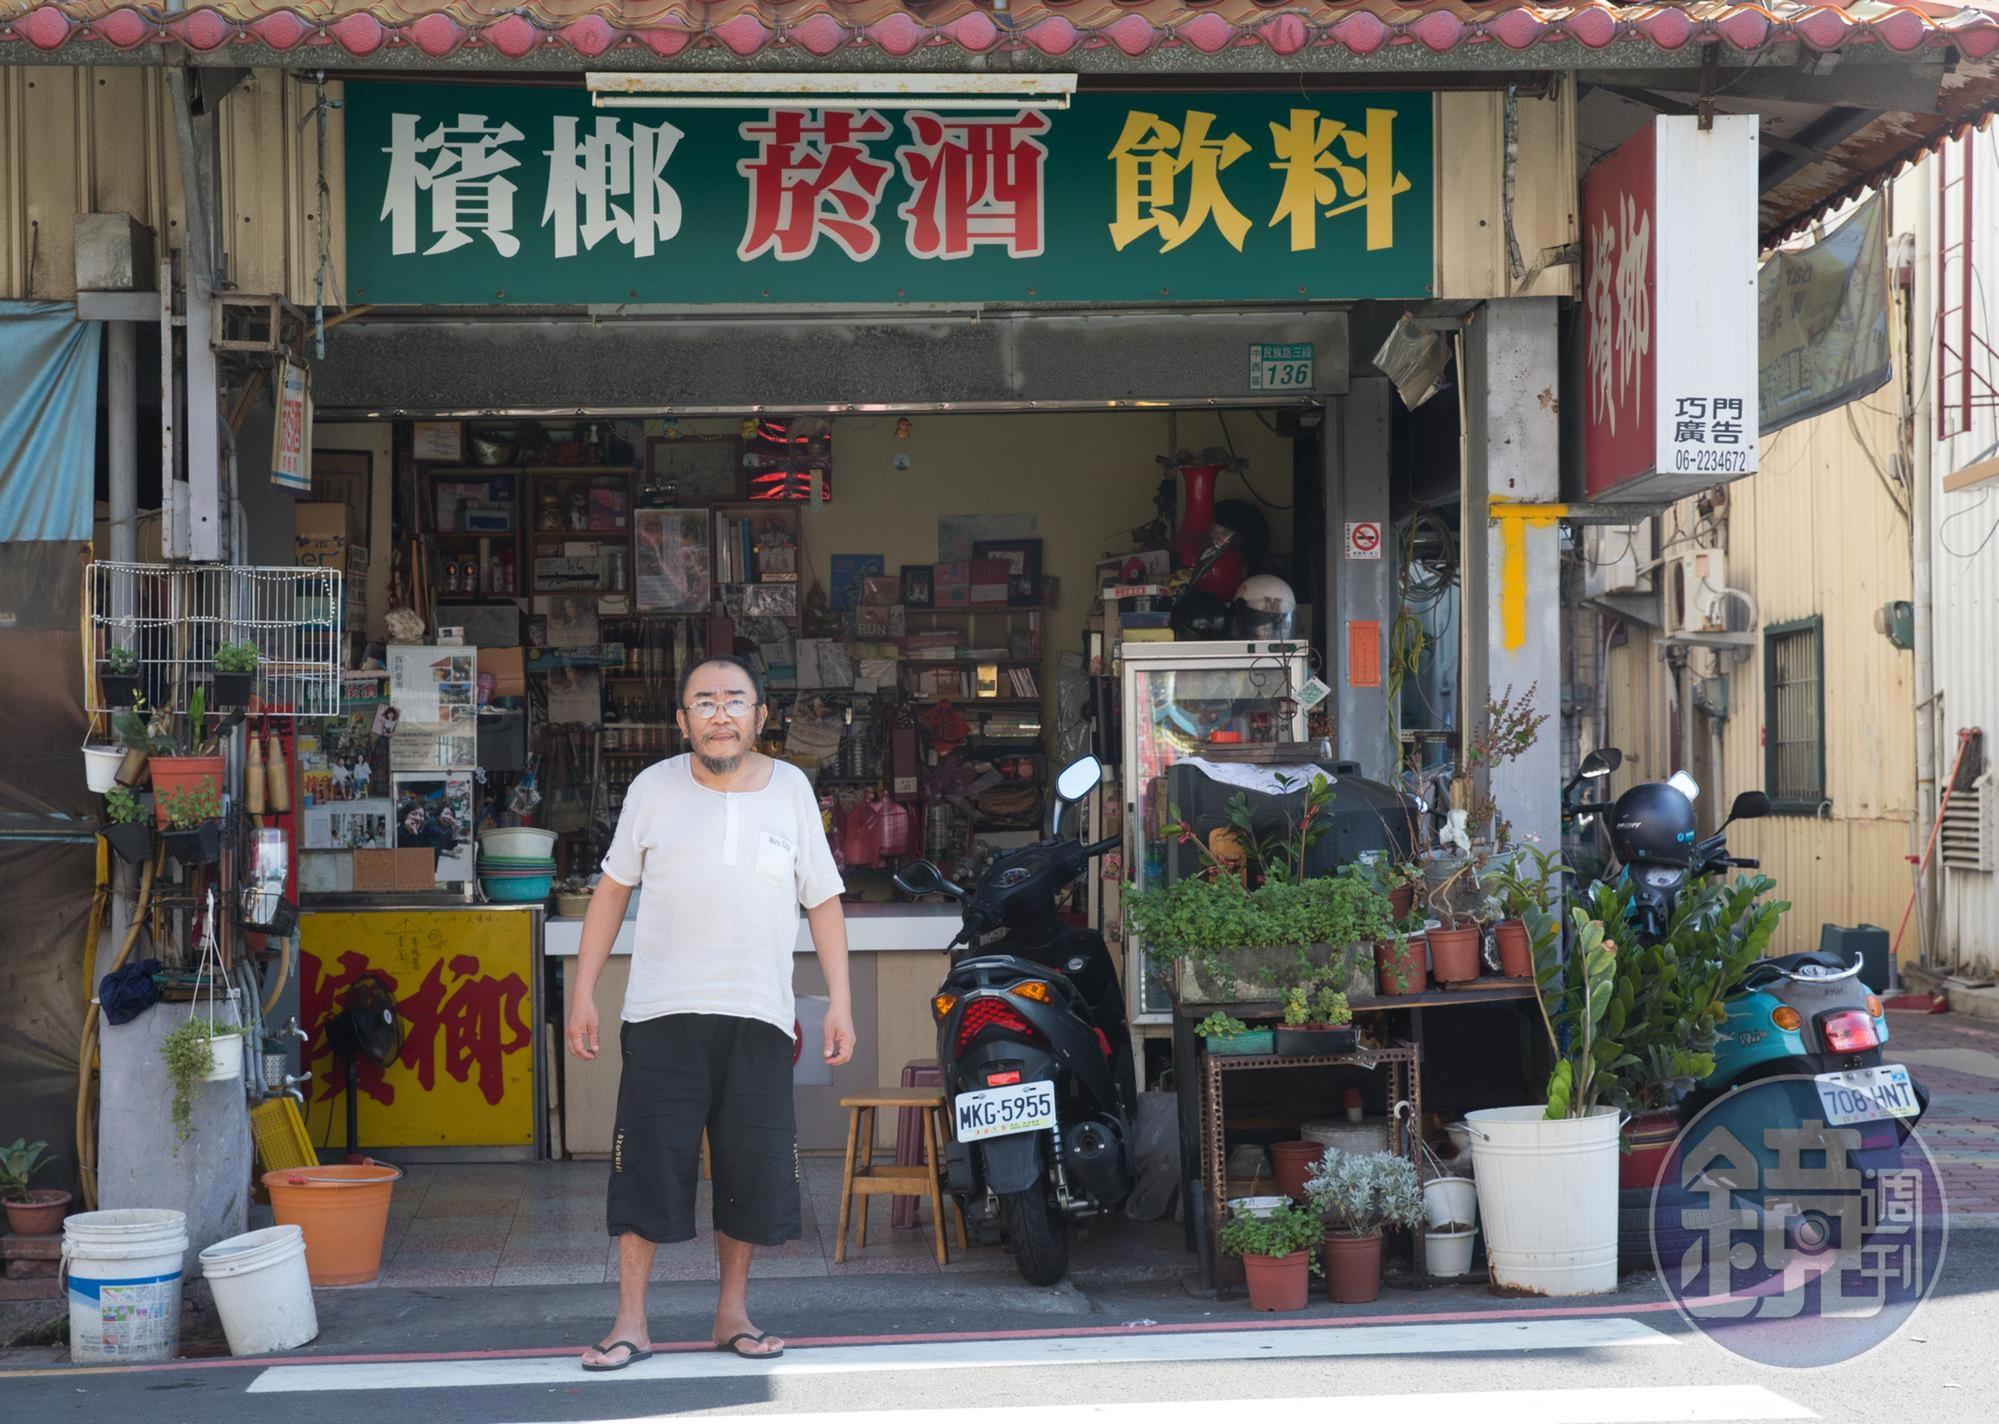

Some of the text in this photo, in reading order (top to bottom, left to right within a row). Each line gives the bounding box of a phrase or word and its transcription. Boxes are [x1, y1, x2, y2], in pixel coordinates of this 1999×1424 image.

[380, 108, 1411, 262] 檳榔 菸酒 飲料
[1587, 190, 1650, 437] 檳榔
[1263, 344, 1313, 359] 民族路三段
[1267, 363, 1309, 386] 136
[1675, 397, 1743, 421] 巧門
[1675, 420, 1743, 444] 廣告
[1675, 449, 1747, 472] 06-2234672
